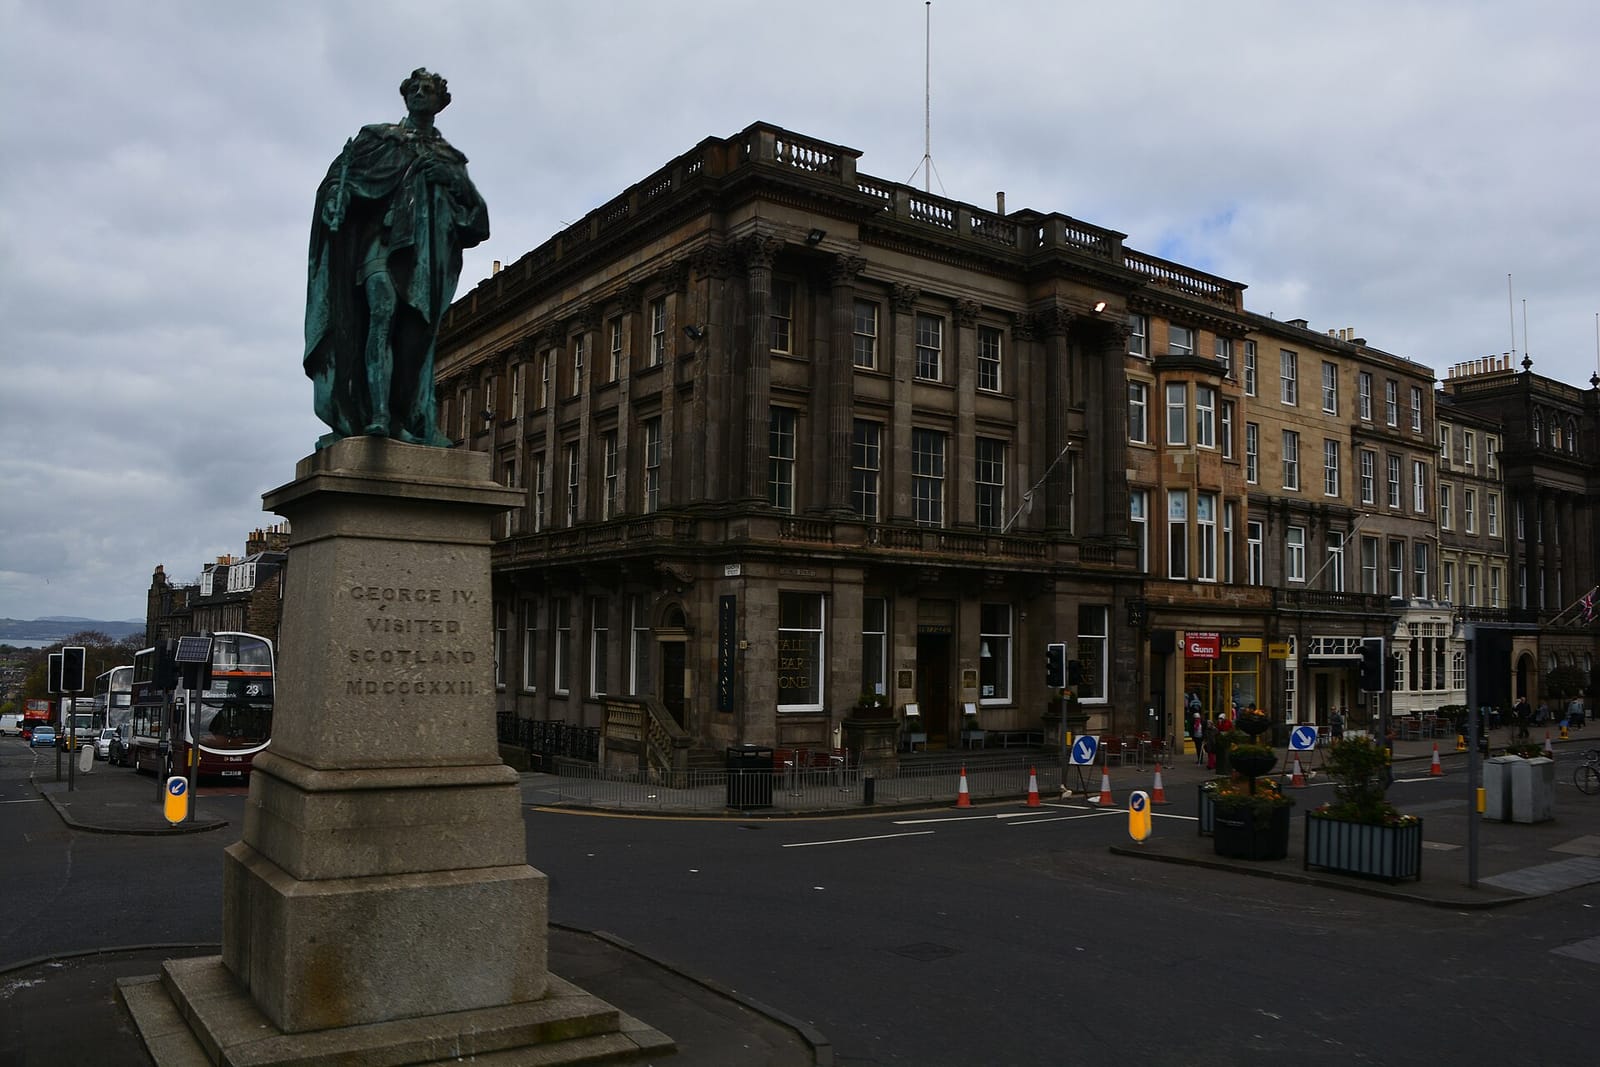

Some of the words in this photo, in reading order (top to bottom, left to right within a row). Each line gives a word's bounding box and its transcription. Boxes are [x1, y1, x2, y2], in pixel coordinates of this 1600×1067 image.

[350, 586, 441, 603] GEORGE
[366, 618, 460, 634] VISITED
[1191, 643, 1214, 653] Gunn
[349, 649, 477, 665] SCOTLAND
[246, 685, 259, 695] 23
